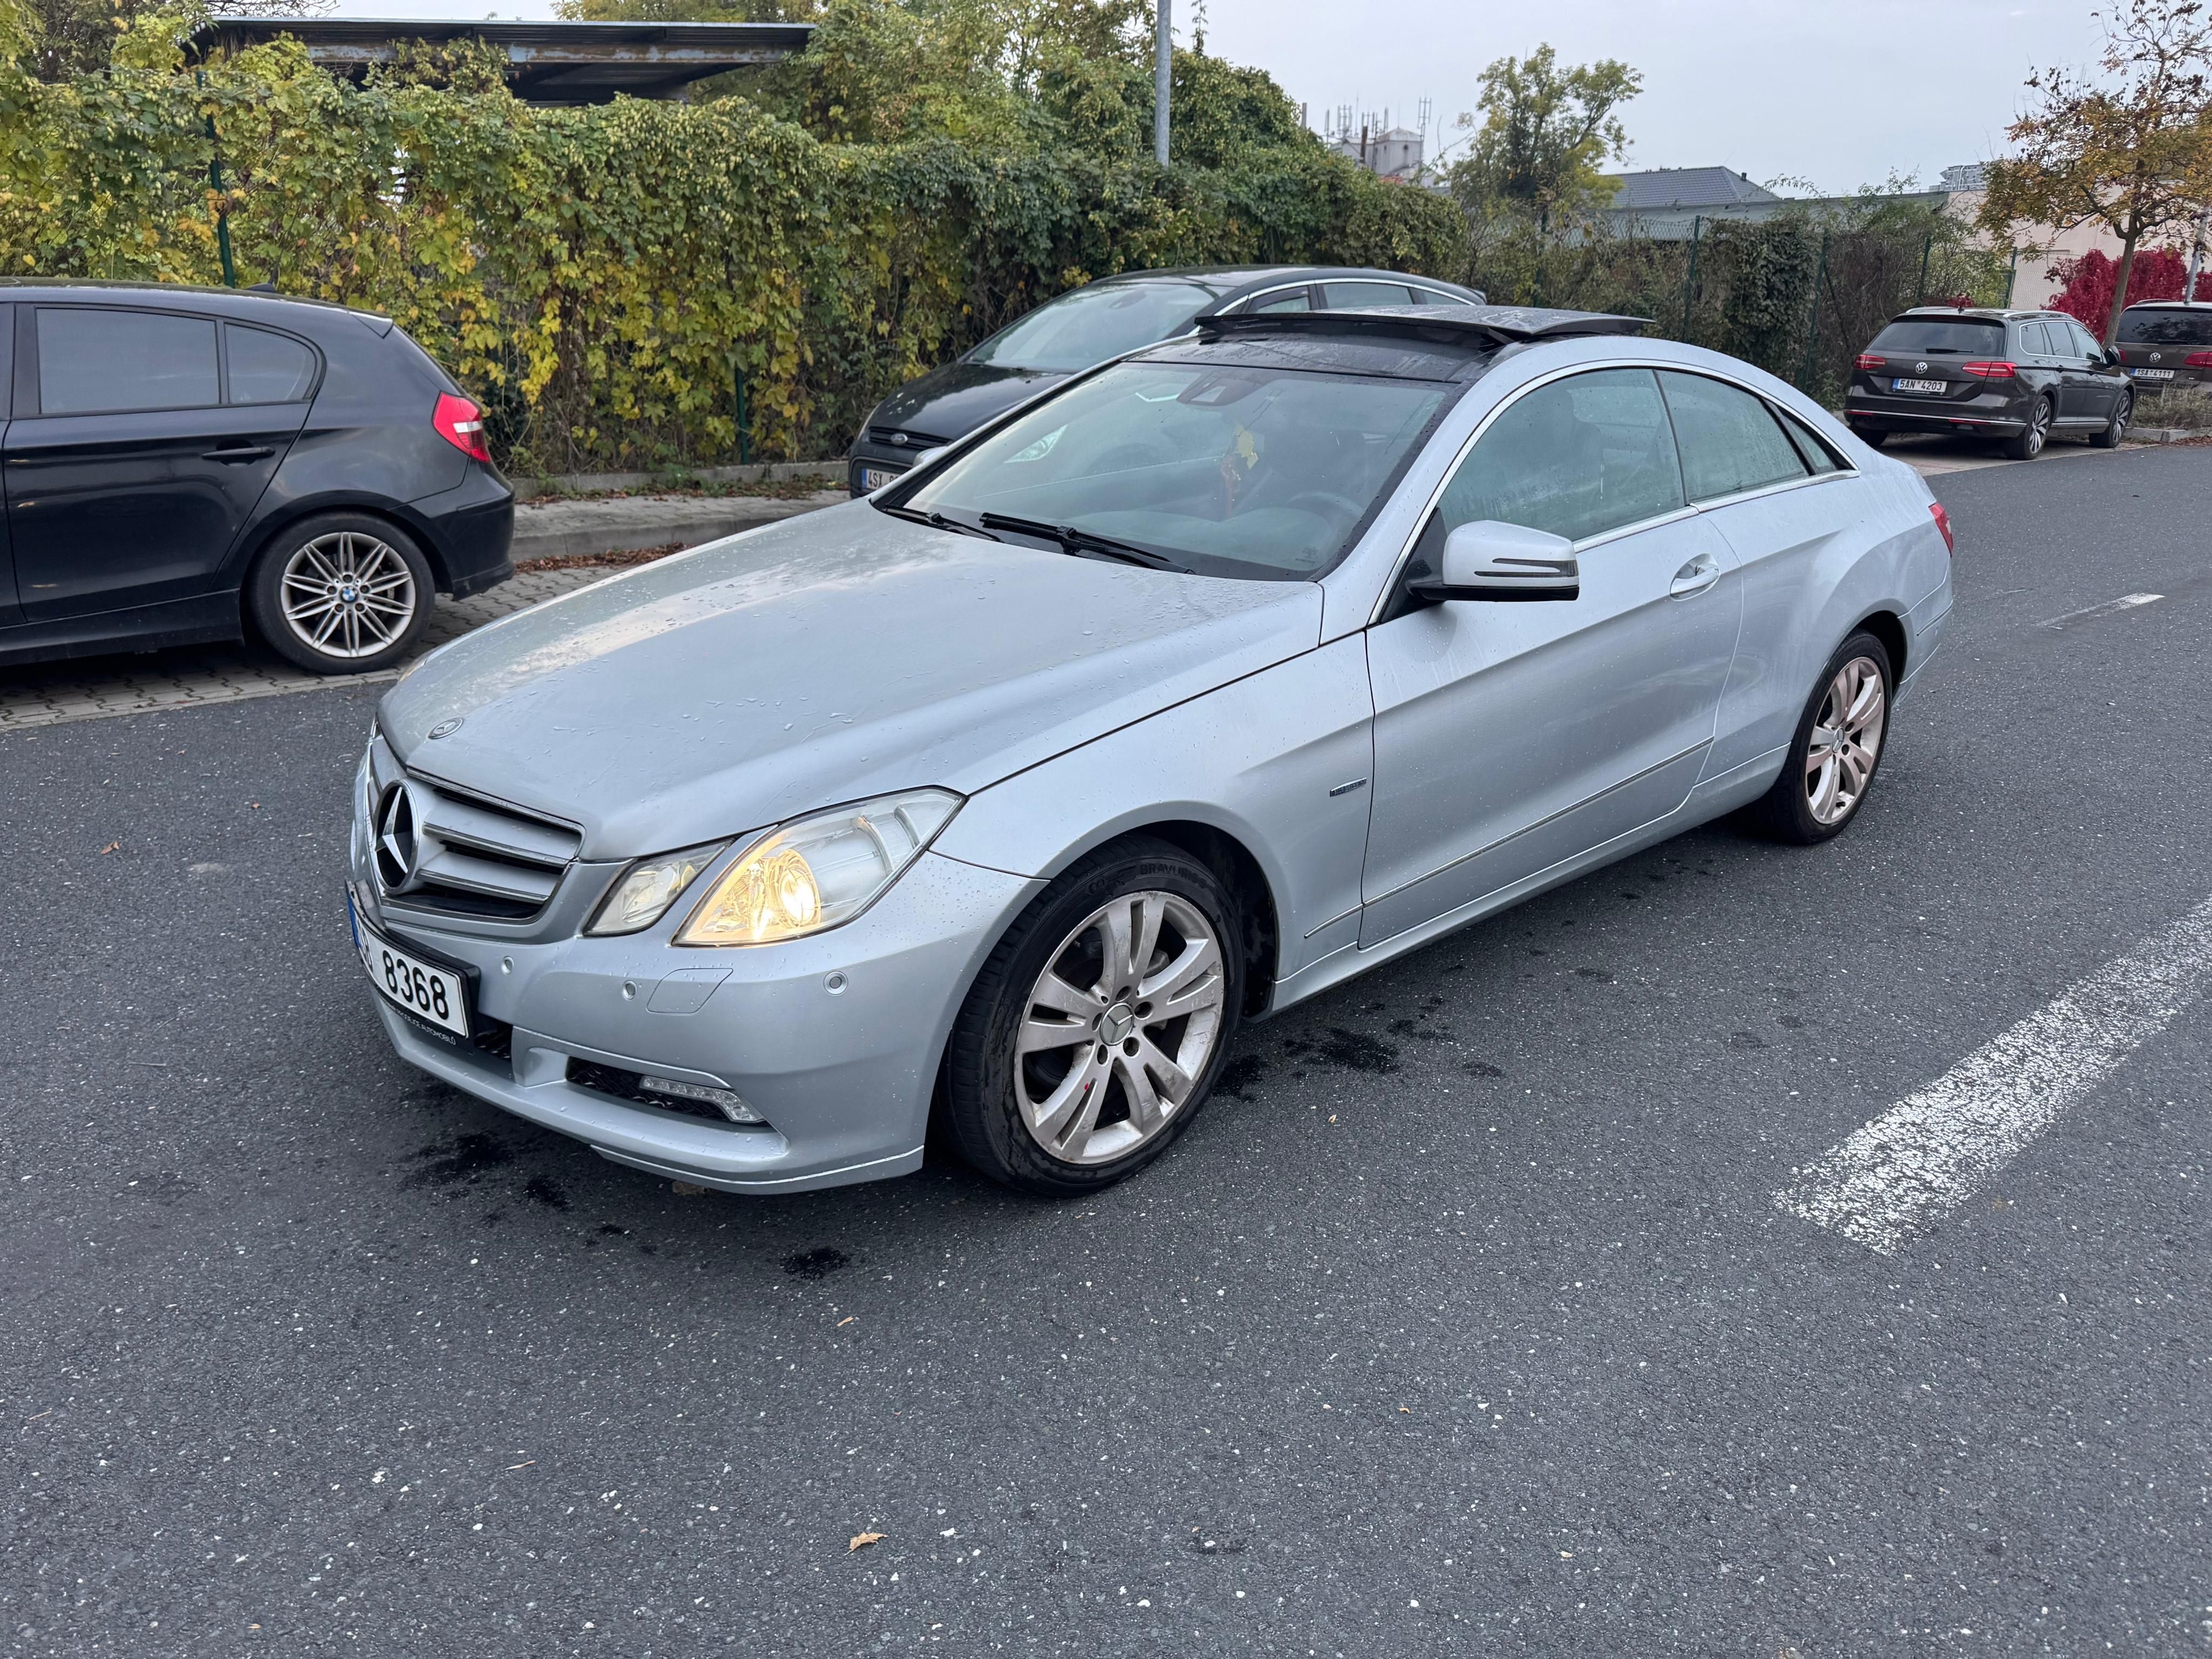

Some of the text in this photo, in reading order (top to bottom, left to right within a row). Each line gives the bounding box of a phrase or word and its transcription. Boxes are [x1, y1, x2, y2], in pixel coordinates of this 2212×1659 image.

[1900, 379, 1943, 390] 5AN 4203
[868, 471, 883, 487] 4SX
[382, 949, 449, 1020] 8368
